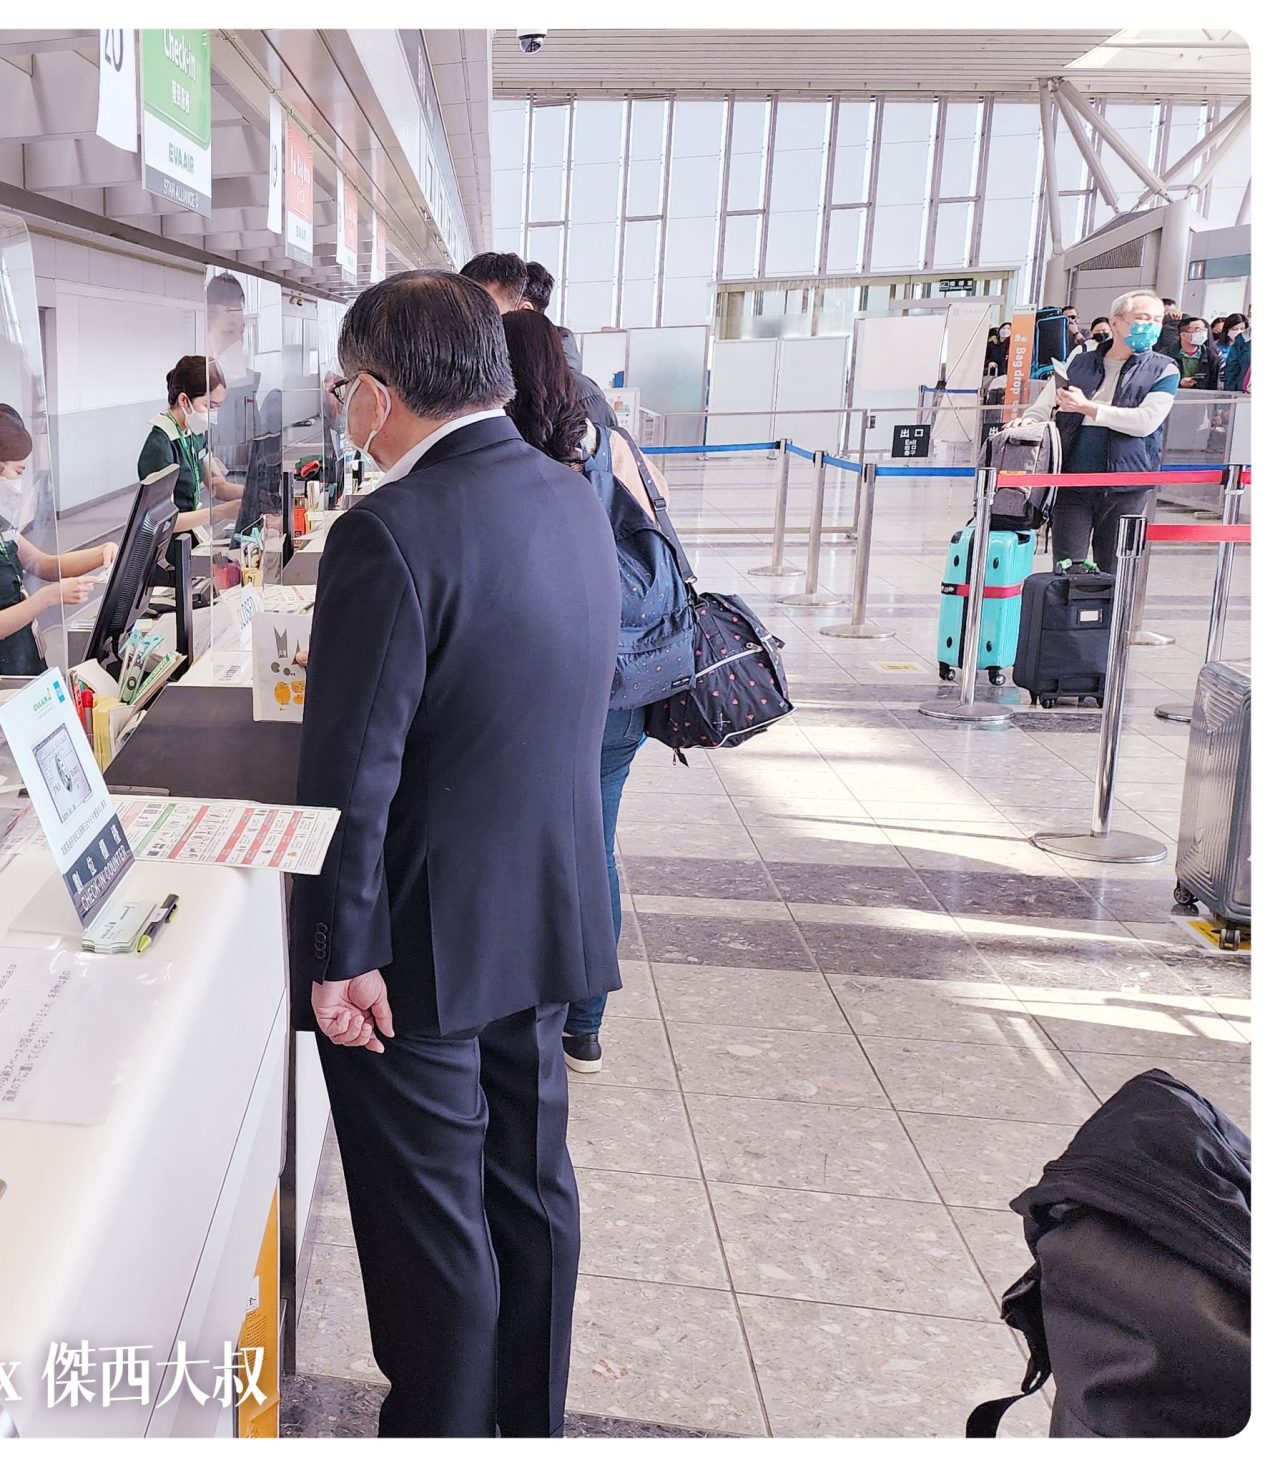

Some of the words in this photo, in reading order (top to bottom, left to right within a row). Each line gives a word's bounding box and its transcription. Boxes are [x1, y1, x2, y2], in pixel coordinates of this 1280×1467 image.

[163, 178, 176, 198] STAR
[176, 184, 195, 208] ALLIANCE
[1013, 347, 1026, 368] Bag
[1012, 368, 1025, 395] drop
[900, 428, 924, 438] 出口
[81, 868, 106, 912] CHECK-IN
[103, 847, 128, 887] COUNTER
